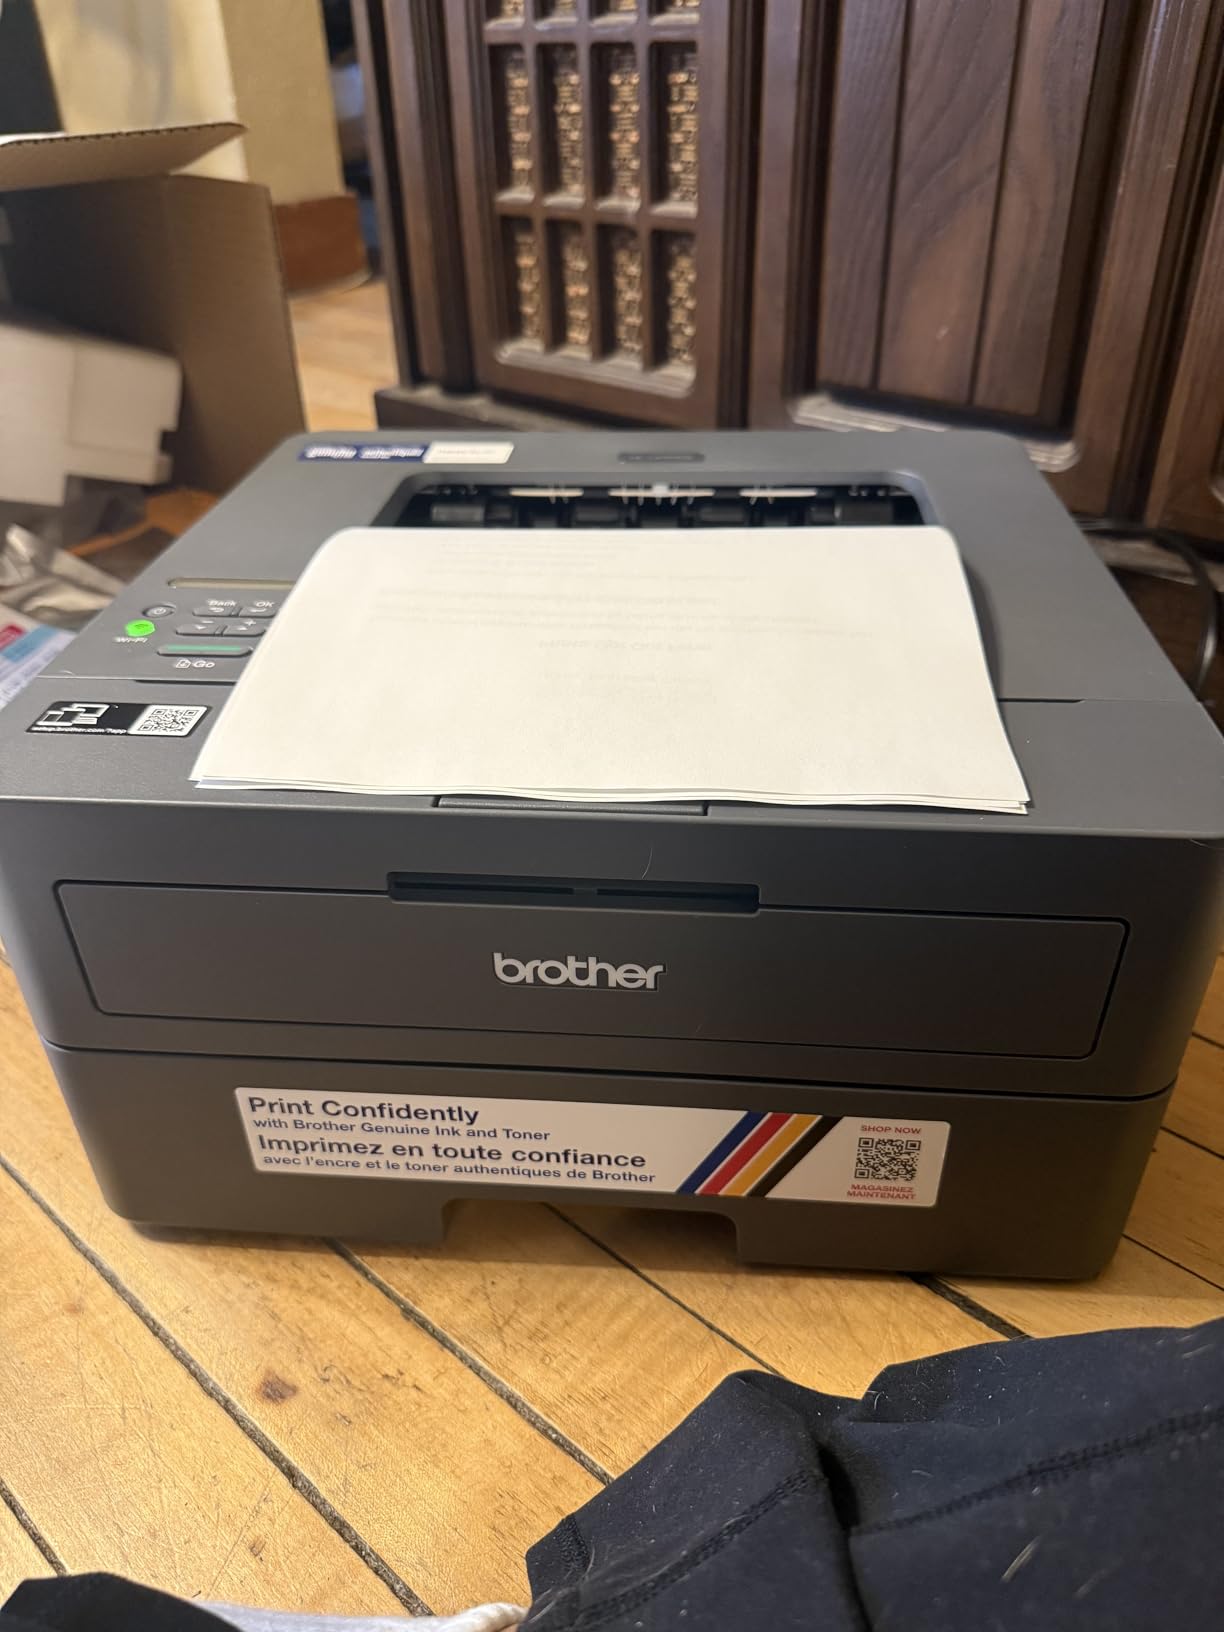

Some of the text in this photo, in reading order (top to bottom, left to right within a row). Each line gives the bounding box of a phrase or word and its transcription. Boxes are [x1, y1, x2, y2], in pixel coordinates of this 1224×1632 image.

[192, 660, 216, 669] Go
[492, 952, 664, 990] brother
[248, 1096, 479, 1126] Print Confidently
[253, 1117, 551, 1141] with Brother Genuine Ink and Toner
[861, 1125, 922, 1134] SHOP NOW
[257, 1134, 646, 1168] Imprimez en toute confiance
[263, 1156, 656, 1183] avec l'encre et le toner authentiques de Brother
[846, 1190, 917, 1200] MAINTENANT
[850, 1184, 914, 1193] MAGASINEZ
